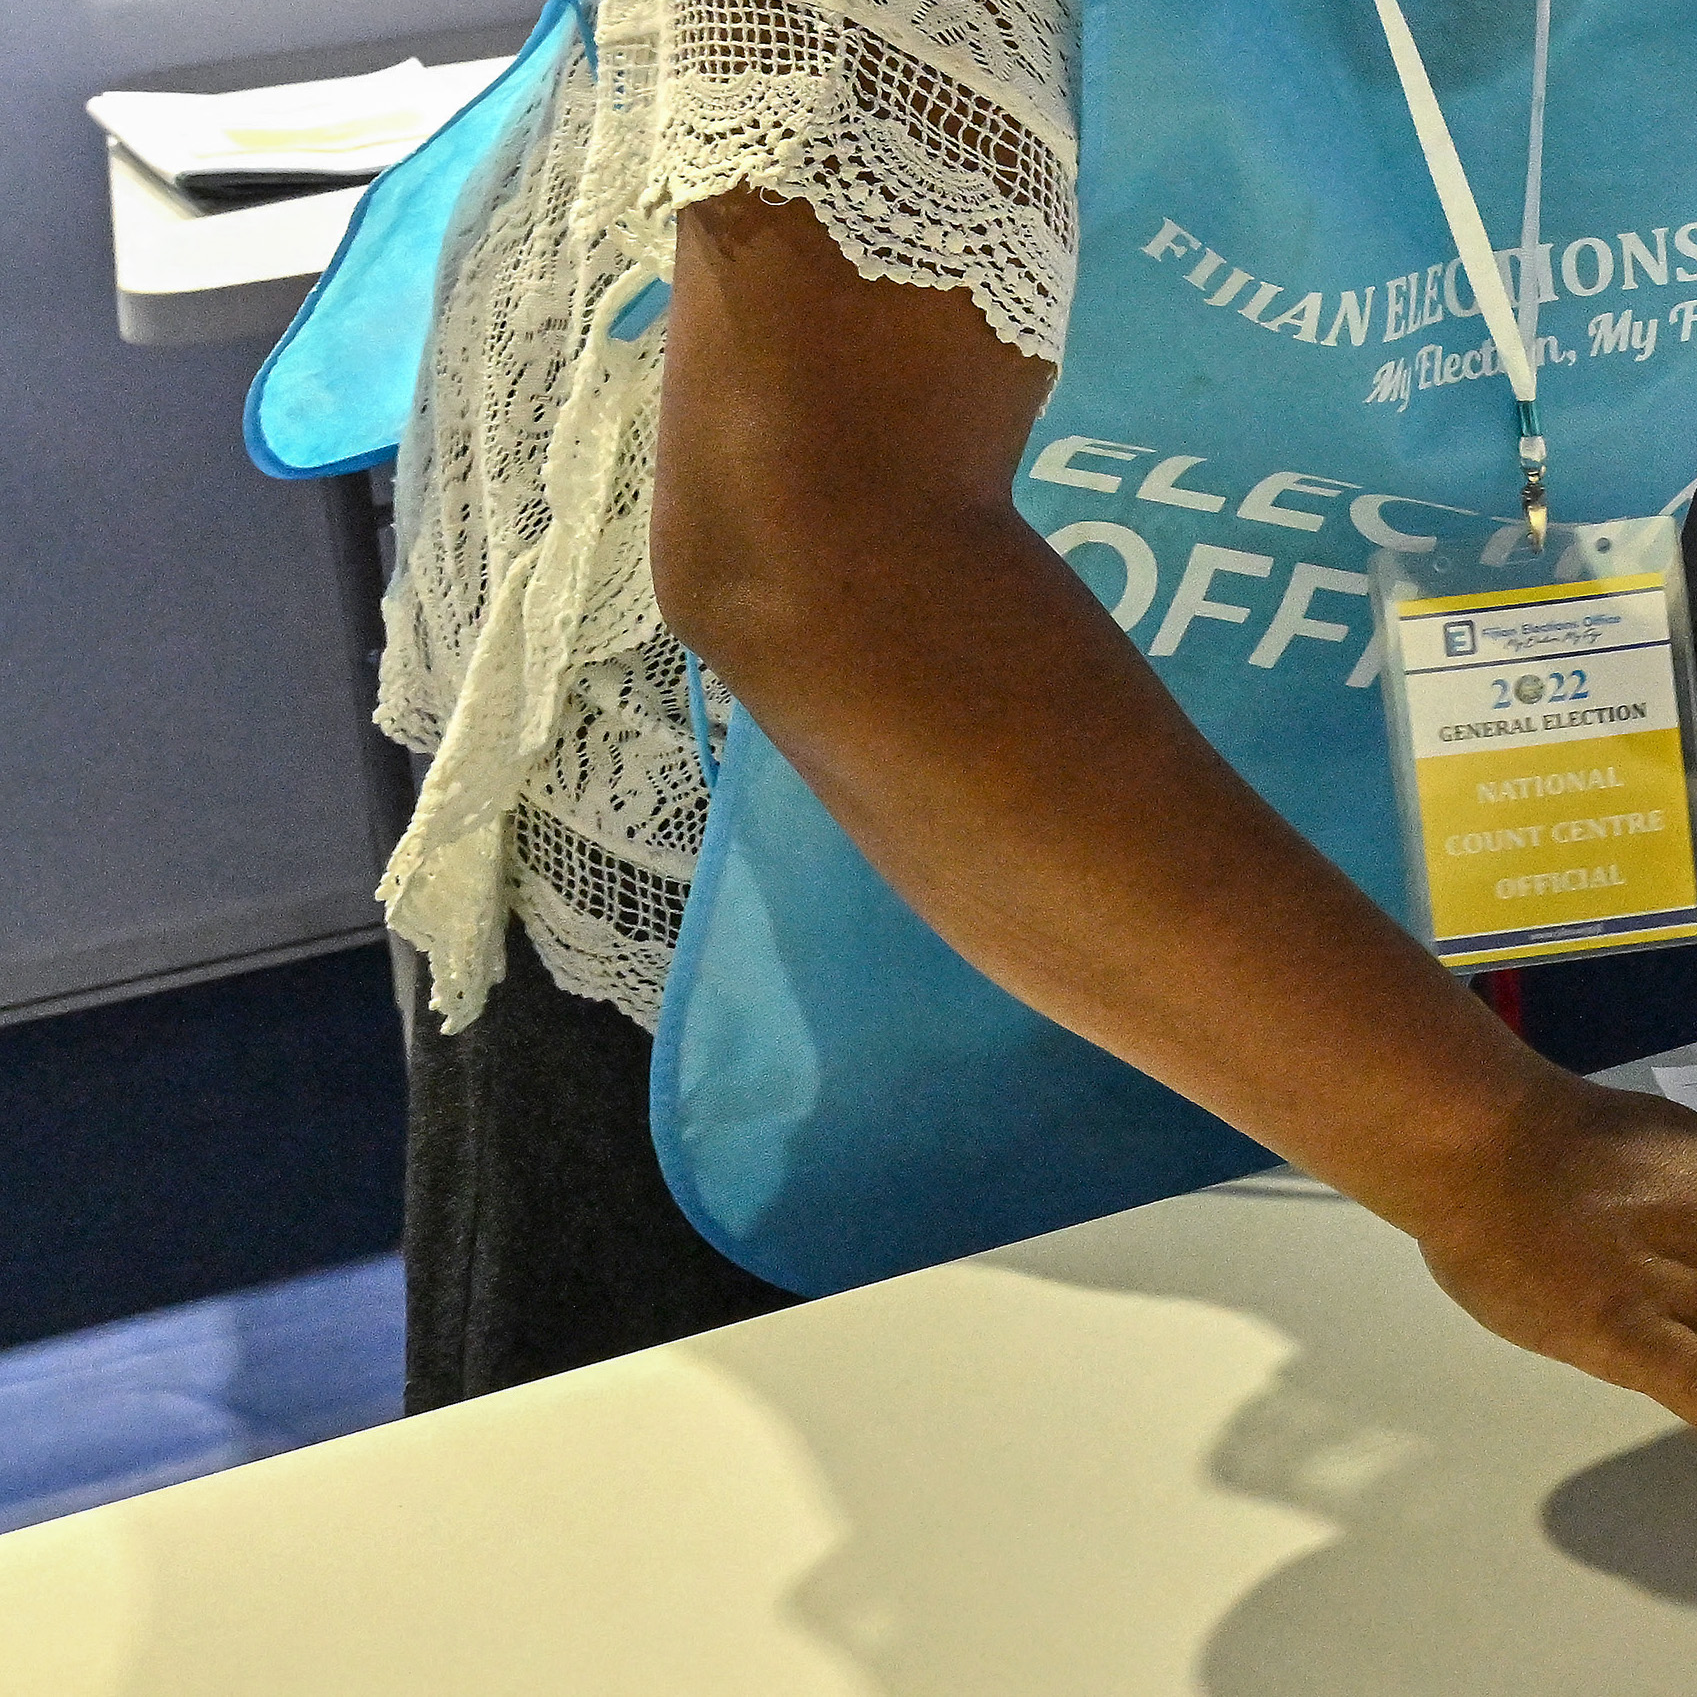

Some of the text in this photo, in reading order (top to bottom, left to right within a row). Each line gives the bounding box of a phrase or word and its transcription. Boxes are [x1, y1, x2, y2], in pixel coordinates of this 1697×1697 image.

[1141, 216, 1376, 347] FIJIAN
[1364, 361, 1410, 413] My
[1589, 310, 1656, 362] My
[1440, 703, 1647, 742] GENERAL ELECTION
[1476, 766, 1625, 804] NATIONAL
[1444, 810, 1665, 856] COUNT CENTRE
[1495, 864, 1627, 899] OFFICIAL
